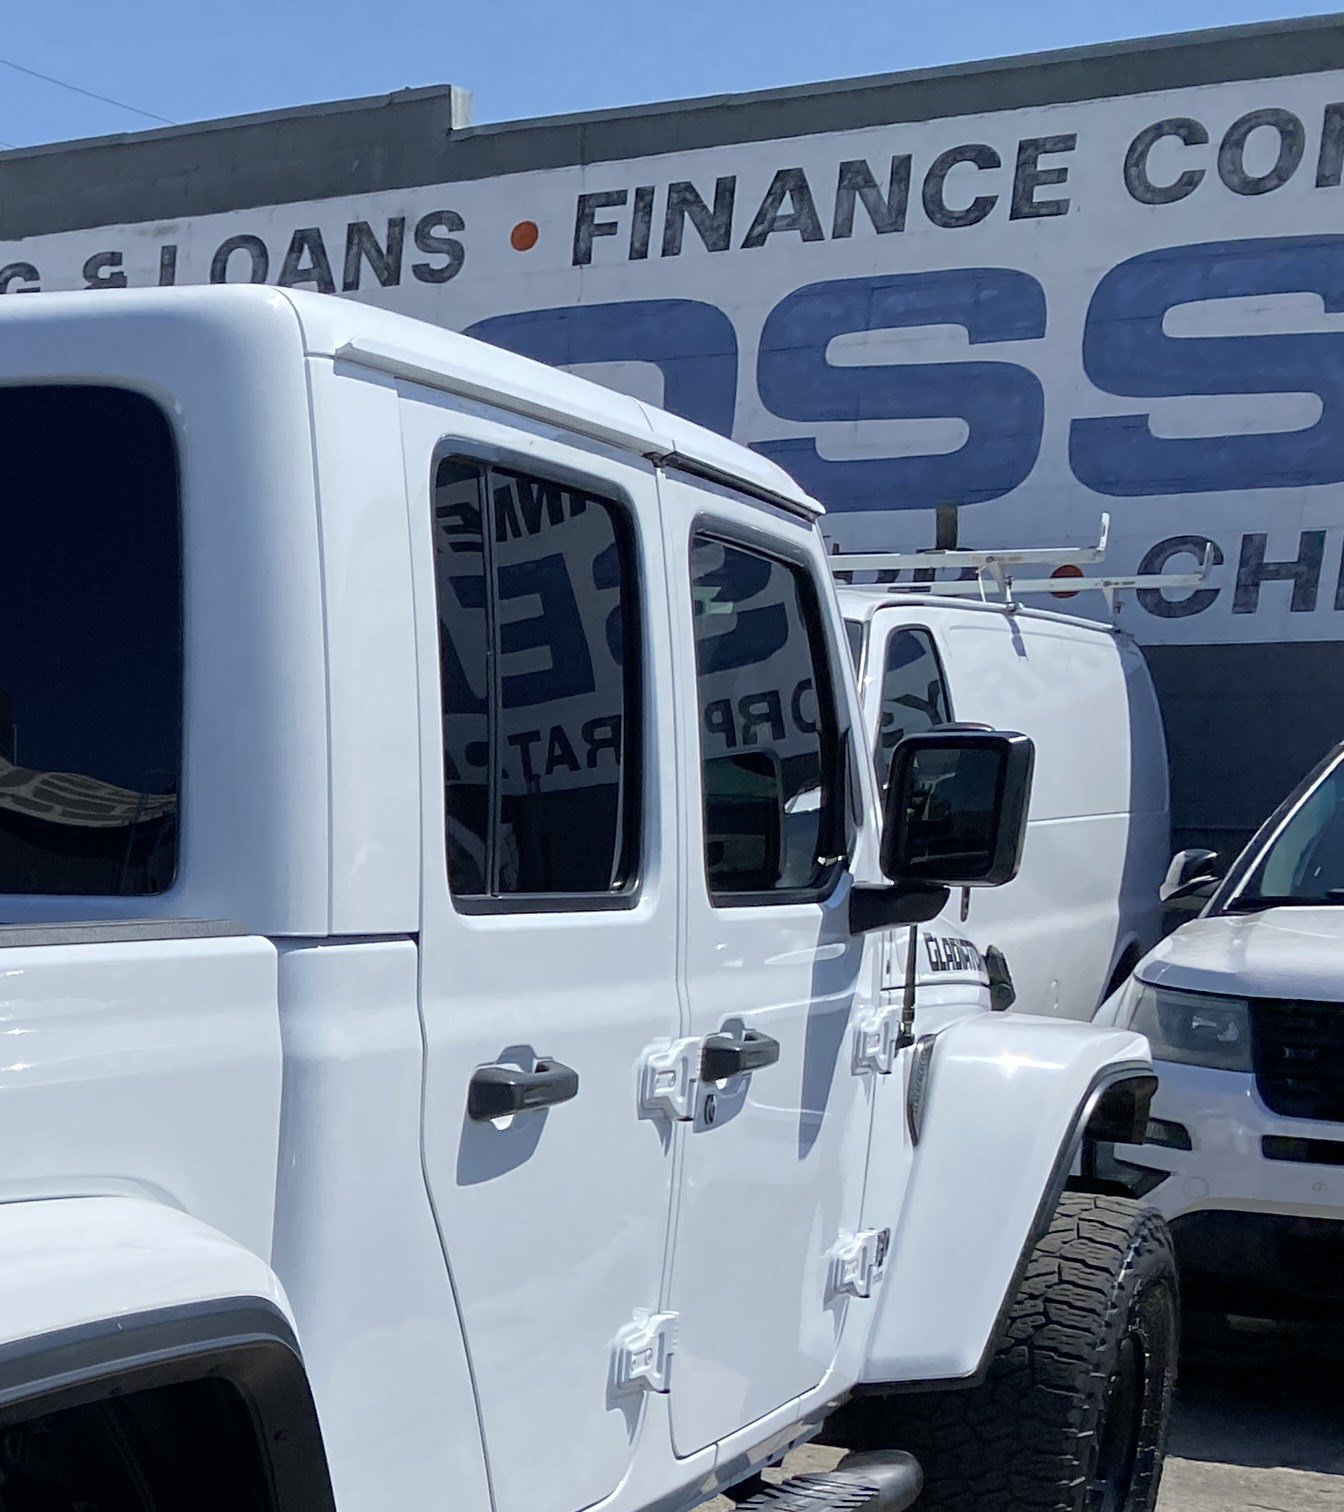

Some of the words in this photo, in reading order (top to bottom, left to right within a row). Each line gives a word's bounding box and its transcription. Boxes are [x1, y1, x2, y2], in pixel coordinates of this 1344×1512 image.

[158, 208, 466, 293] LOANS
[572, 132, 1078, 267] FINANCE
[1123, 101, 1344, 205] CO
[1136, 529, 1344, 619] CH
